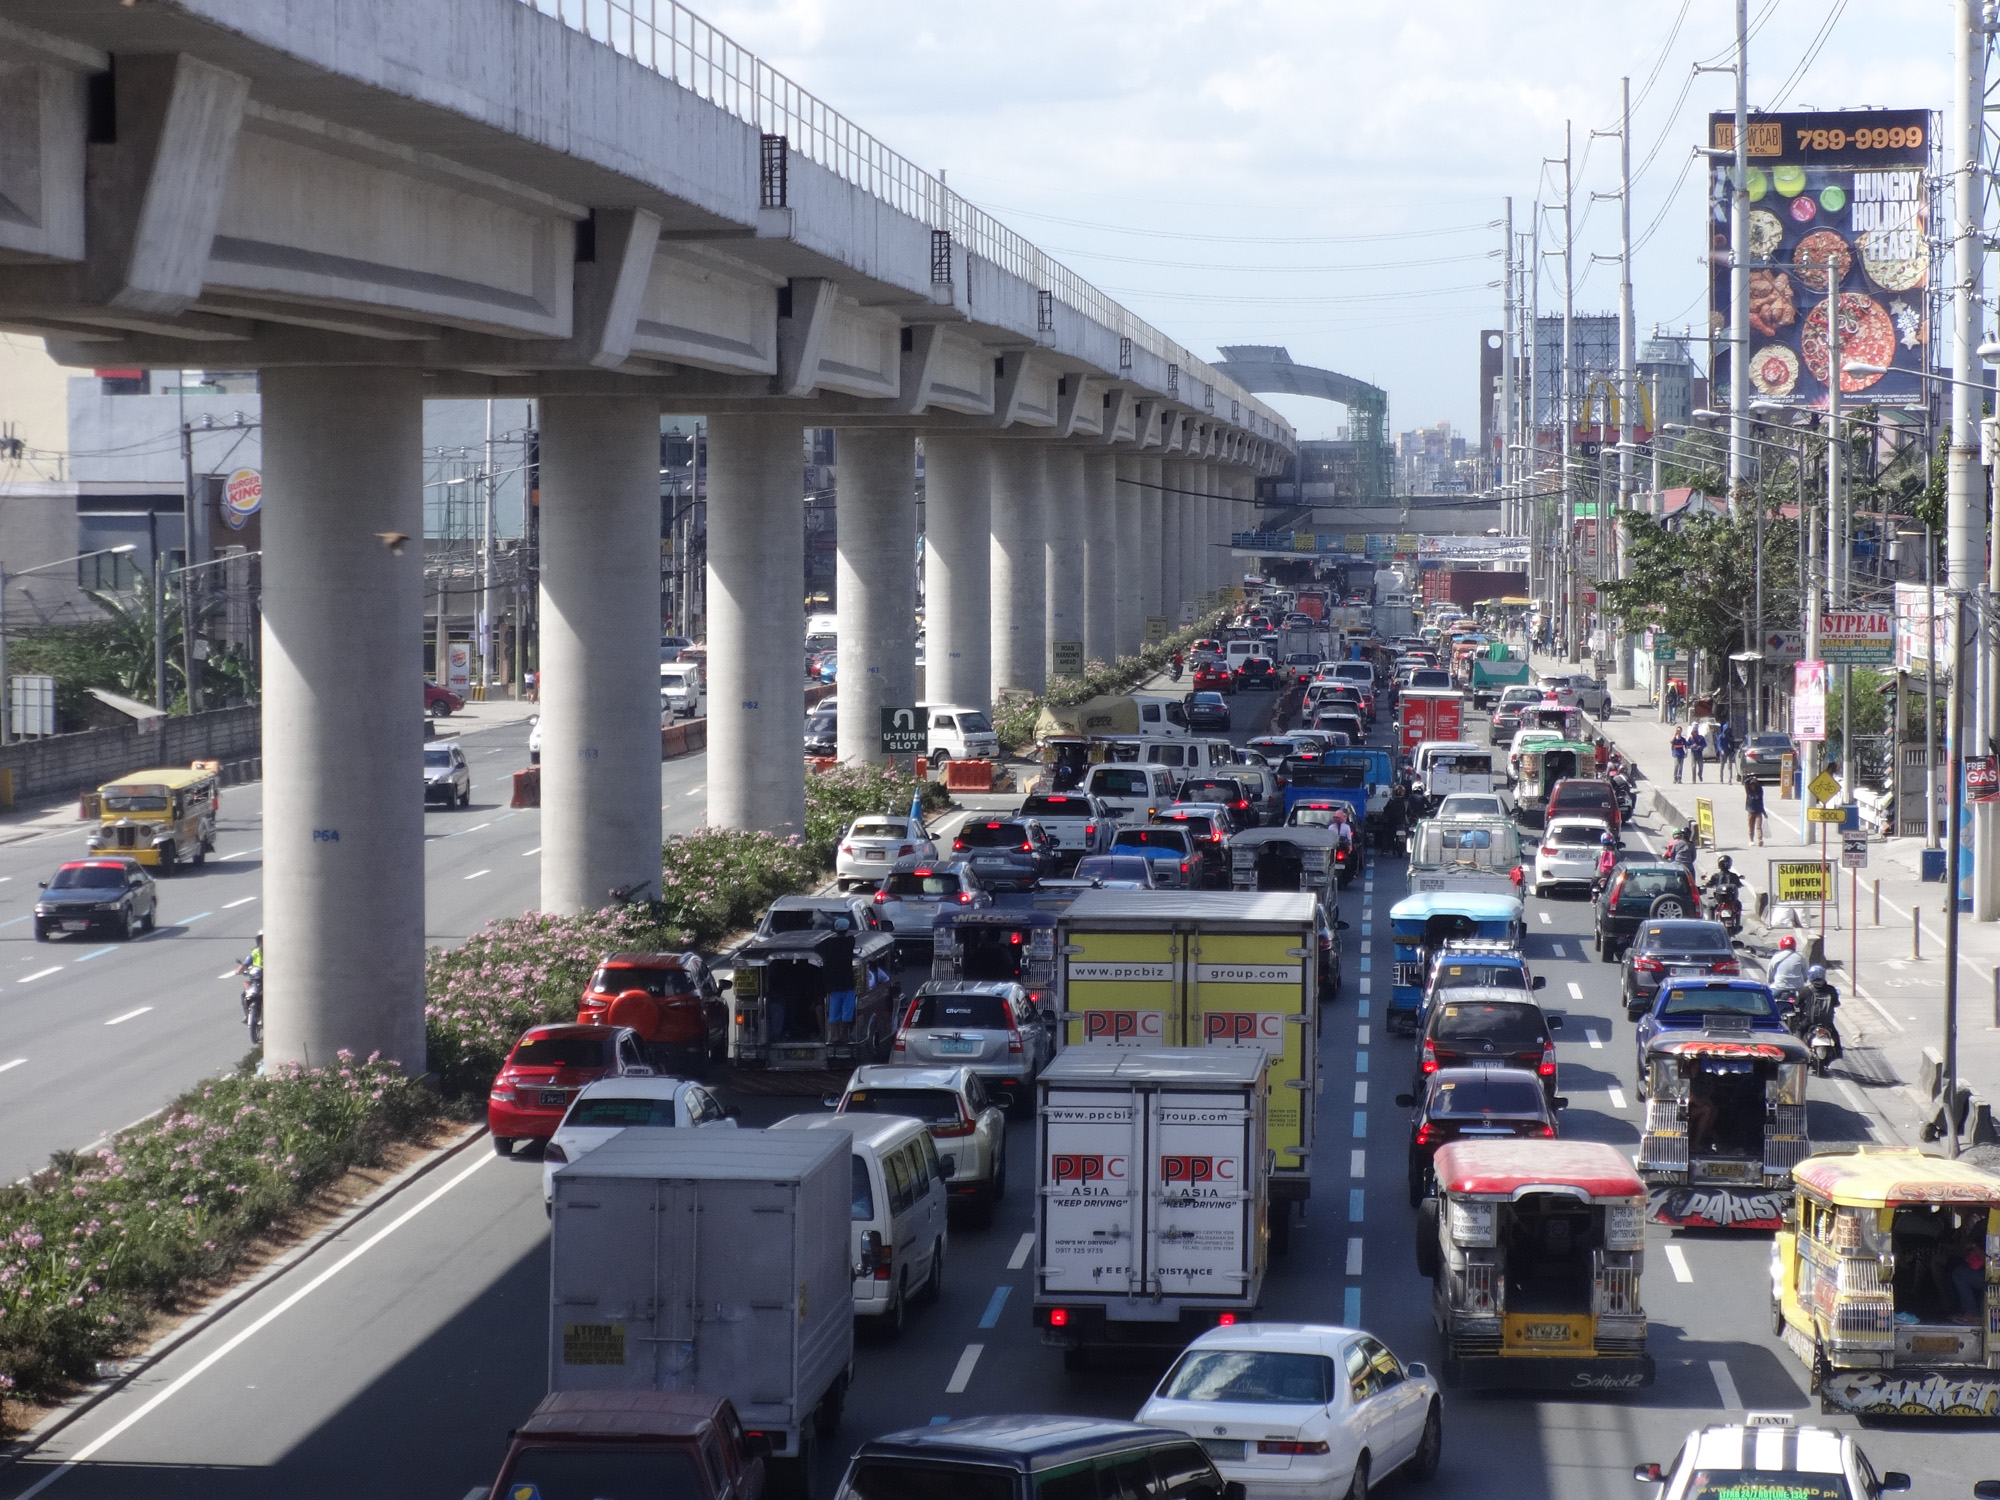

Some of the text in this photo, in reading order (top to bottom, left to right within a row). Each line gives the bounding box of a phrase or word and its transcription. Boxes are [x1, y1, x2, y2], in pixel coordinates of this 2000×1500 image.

[1718, 127, 1778, 146] YELW CAB
[1797, 127, 1923, 150] 789-9999
[1854, 172, 1920, 202] HUNGRY
[1852, 202, 1920, 232] HOLIDAY
[1868, 230, 1919, 260] FEAST
[228, 476, 259, 492] BURGER
[230, 484, 262, 504] KING
[1802, 614, 1889, 632] STPEAK
[743, 701, 758, 710] P62
[884, 732, 925, 740] U-TURN
[890, 742, 919, 750] SLOT
[1966, 762, 1986, 770] FREE
[1967, 770, 1996, 783] GAS
[1812, 812, 1840, 820] SCHOOL
[1780, 864, 1830, 874] SLOWDOWN
[1790, 878, 1821, 887] UNEVEN
[1784, 891, 1827, 900] PAVEMEN
[1076, 967, 1288, 980] www.ppcbiz group.com
[1088, 1013, 1279, 1044] PPC PPC
[1054, 1111, 1228, 1122] www.ppcbiz group.com
[1056, 1156, 1234, 1187] PPC PPC
[1072, 1187, 1218, 1198] ASIA ASIA
[1084, 1200, 1128, 1208] DRIVING"
[1193, 1201, 1236, 1209] DRIVING"
[1680, 1189, 1797, 1225] PAKIST
[1756, 1416, 1788, 1425] TAXI
[1719, 1491, 1740, 1499] LTFRB
